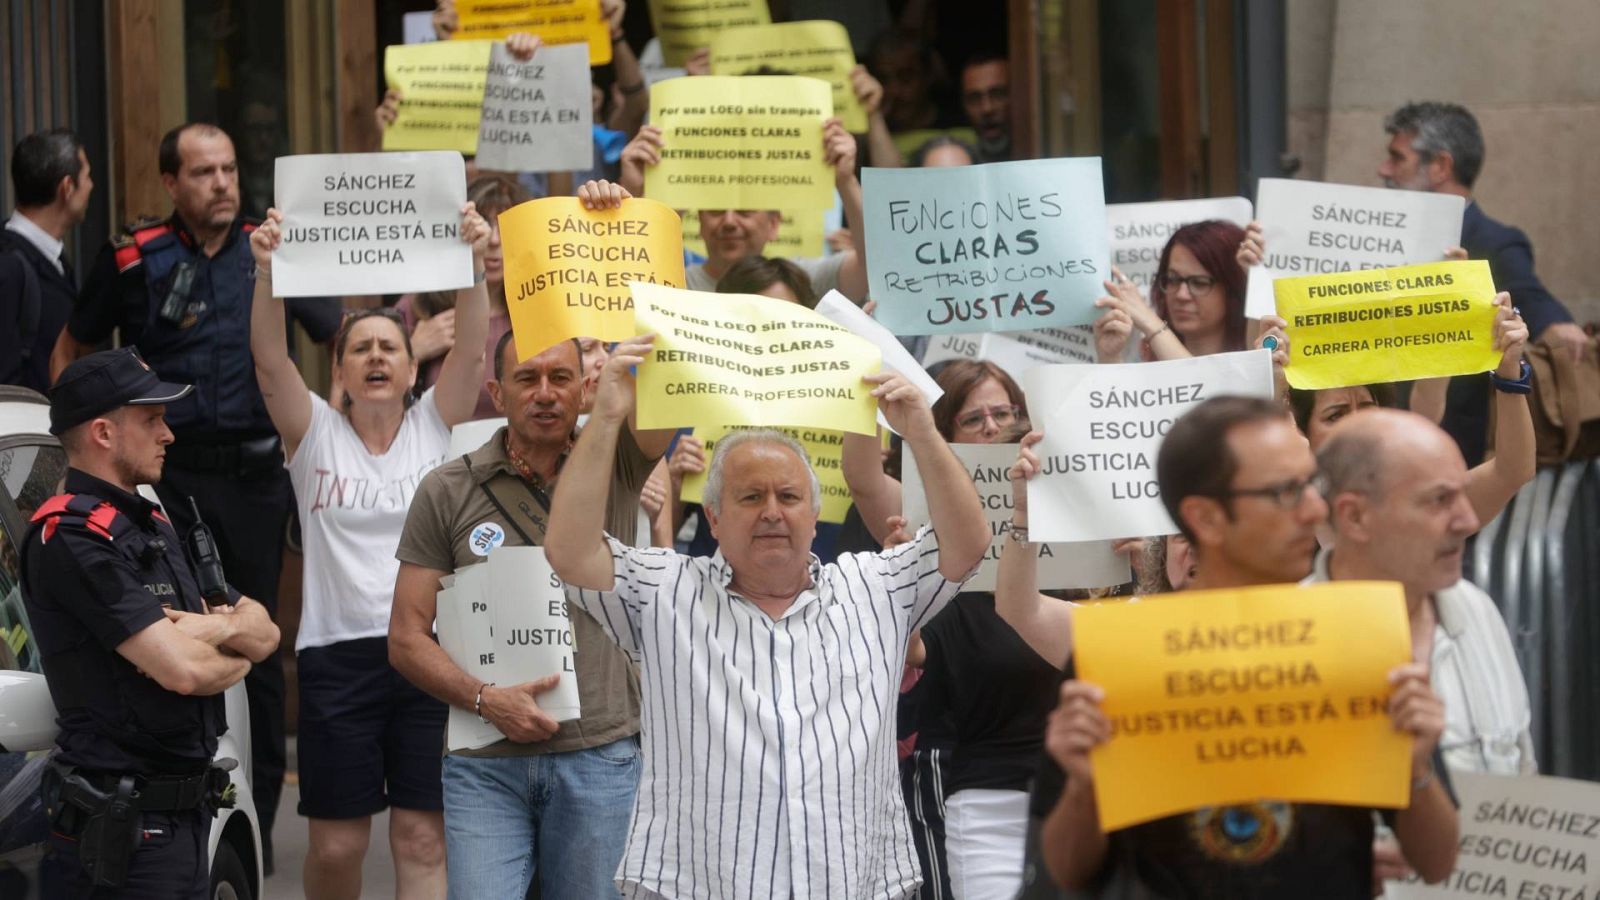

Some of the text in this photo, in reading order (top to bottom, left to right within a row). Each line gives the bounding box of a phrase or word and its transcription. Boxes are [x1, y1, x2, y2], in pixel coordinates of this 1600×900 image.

[488, 64, 545, 80] ÁNCHEZ
[486, 86, 545, 101] SCUCHA
[509, 108, 552, 124] ESTÁ
[558, 109, 579, 123] EN
[683, 107, 706, 115] una
[747, 105, 766, 115] sin
[770, 106, 821, 117] trampas
[481, 129, 533, 145] LUCHA
[674, 127, 801, 137] FUNCIONES CLARAS
[661, 150, 811, 160] RETRIBUCIONES JUSTAS
[324, 172, 415, 191] SÁNCHEZ
[668, 175, 814, 185] CARRERA PROFESIONAL
[324, 200, 416, 216] ESCUCHA
[1312, 203, 1407, 229] SÁNCHEZ
[284, 221, 457, 243] JUSTICIA ESTÁ EN
[548, 215, 649, 236] SÁNCHEZ
[1114, 221, 1178, 239] SÁNCH
[549, 243, 650, 263] ESCUCHA
[915, 229, 1040, 265] CLARAS
[1308, 231, 1405, 255] ESCUCHA
[339, 250, 404, 265] LUCHA
[1264, 253, 1352, 273] JUSTICIA
[517, 268, 599, 301] JUSTICIA
[1308, 274, 1454, 299] FUNCIONES CLARAS
[566, 292, 635, 311] LUCHA
[927, 290, 1056, 325] JUSTAS
[650, 304, 676, 318] Por
[681, 314, 709, 328] una
[761, 320, 786, 332] sin
[1295, 299, 1470, 327] RETRIBUCIONES JUSTAS
[673, 328, 834, 356] FUNCIONES CLARAS
[1033, 327, 1088, 347] USTICIA
[1303, 330, 1474, 357] CARRERA PROFESIONAL
[656, 350, 850, 377] RETRIBUCIONES JUSTAS
[665, 383, 855, 401] CARRERA PROFESIONAL
[1089, 383, 1205, 409] SÁNCHEZ
[803, 431, 843, 445] CLAR
[1090, 418, 1173, 440] ESCUC
[1042, 453, 1150, 476] JUSTICIA
[1112, 481, 1160, 500] LUC
[475, 526, 496, 549] STAJ
[507, 629, 572, 646] JUSTIC
[1164, 618, 1316, 655] SÁNCHEZ
[1165, 661, 1322, 697] ESCUCHA
[1108, 696, 1391, 738] JUSTICIA ESTÁ EN
[1196, 736, 1307, 762] LUCHA
[1475, 797, 1600, 839] SÁNCHEZ
[1460, 834, 1588, 874] ESCUCHA
